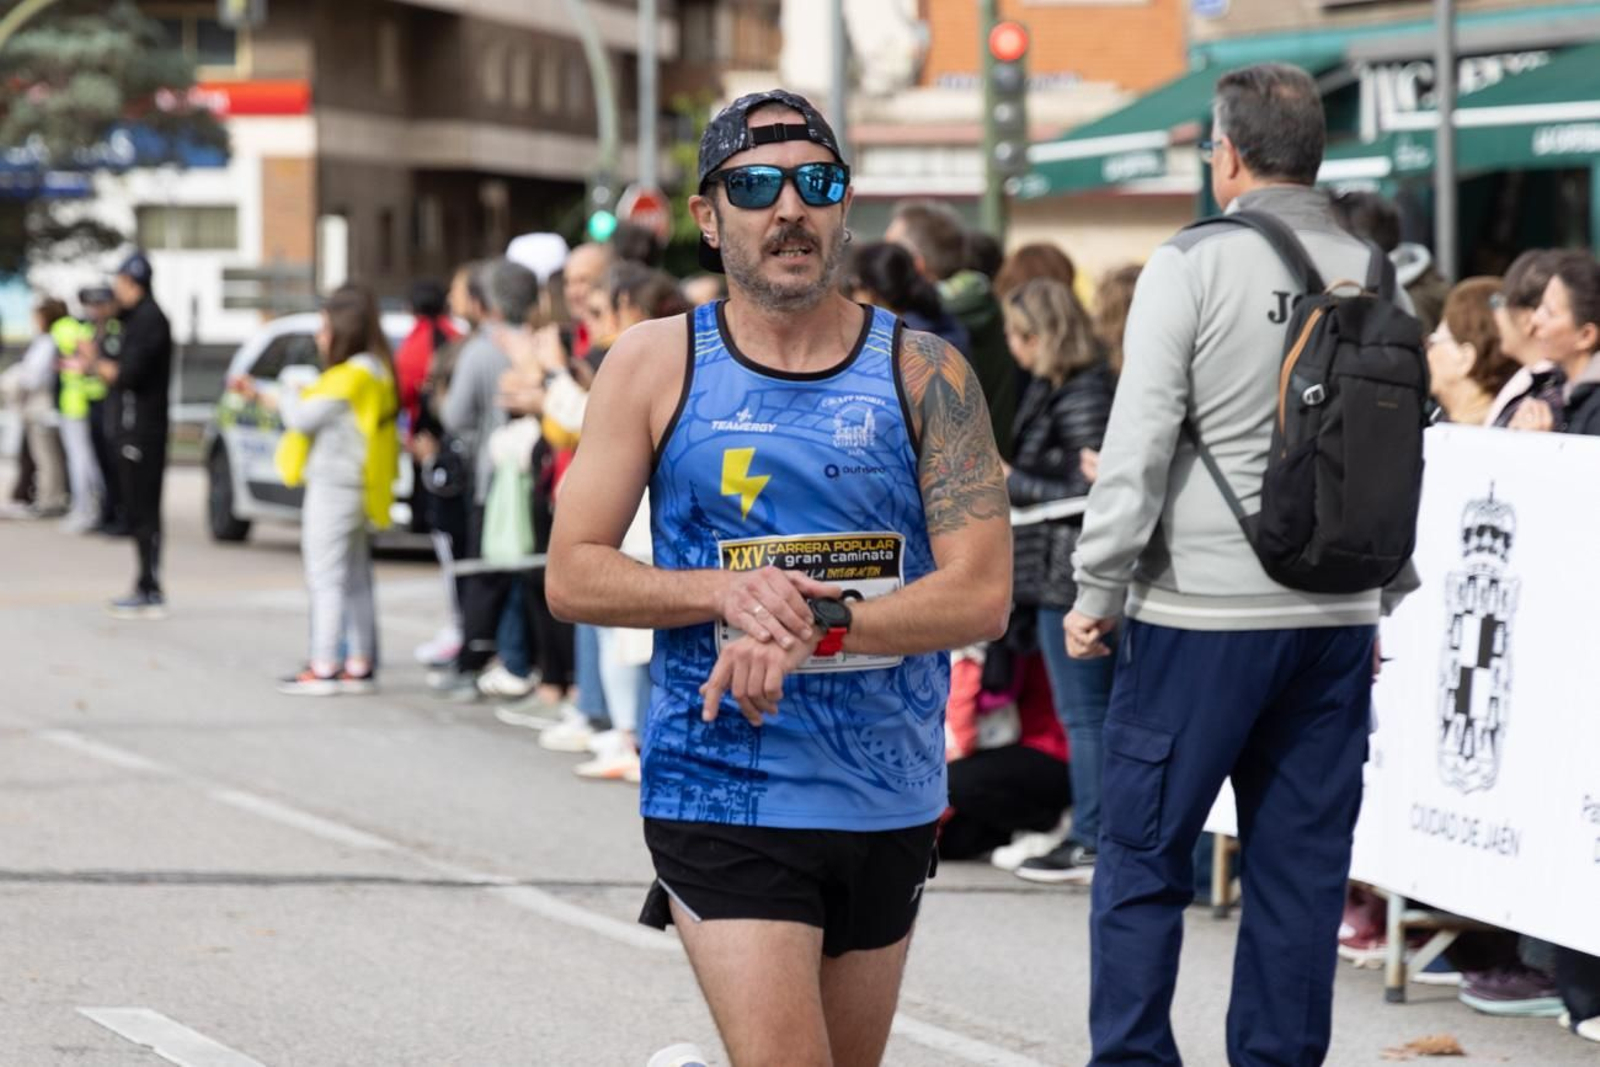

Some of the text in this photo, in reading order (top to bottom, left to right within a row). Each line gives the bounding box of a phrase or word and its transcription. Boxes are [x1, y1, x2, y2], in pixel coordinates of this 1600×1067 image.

[711, 421, 777, 432] TEAMERGY
[767, 538, 895, 555] CARRERA POPULAR
[728, 544, 766, 571] XXV
[785, 554, 823, 567] gran
[829, 549, 894, 563] caminata
